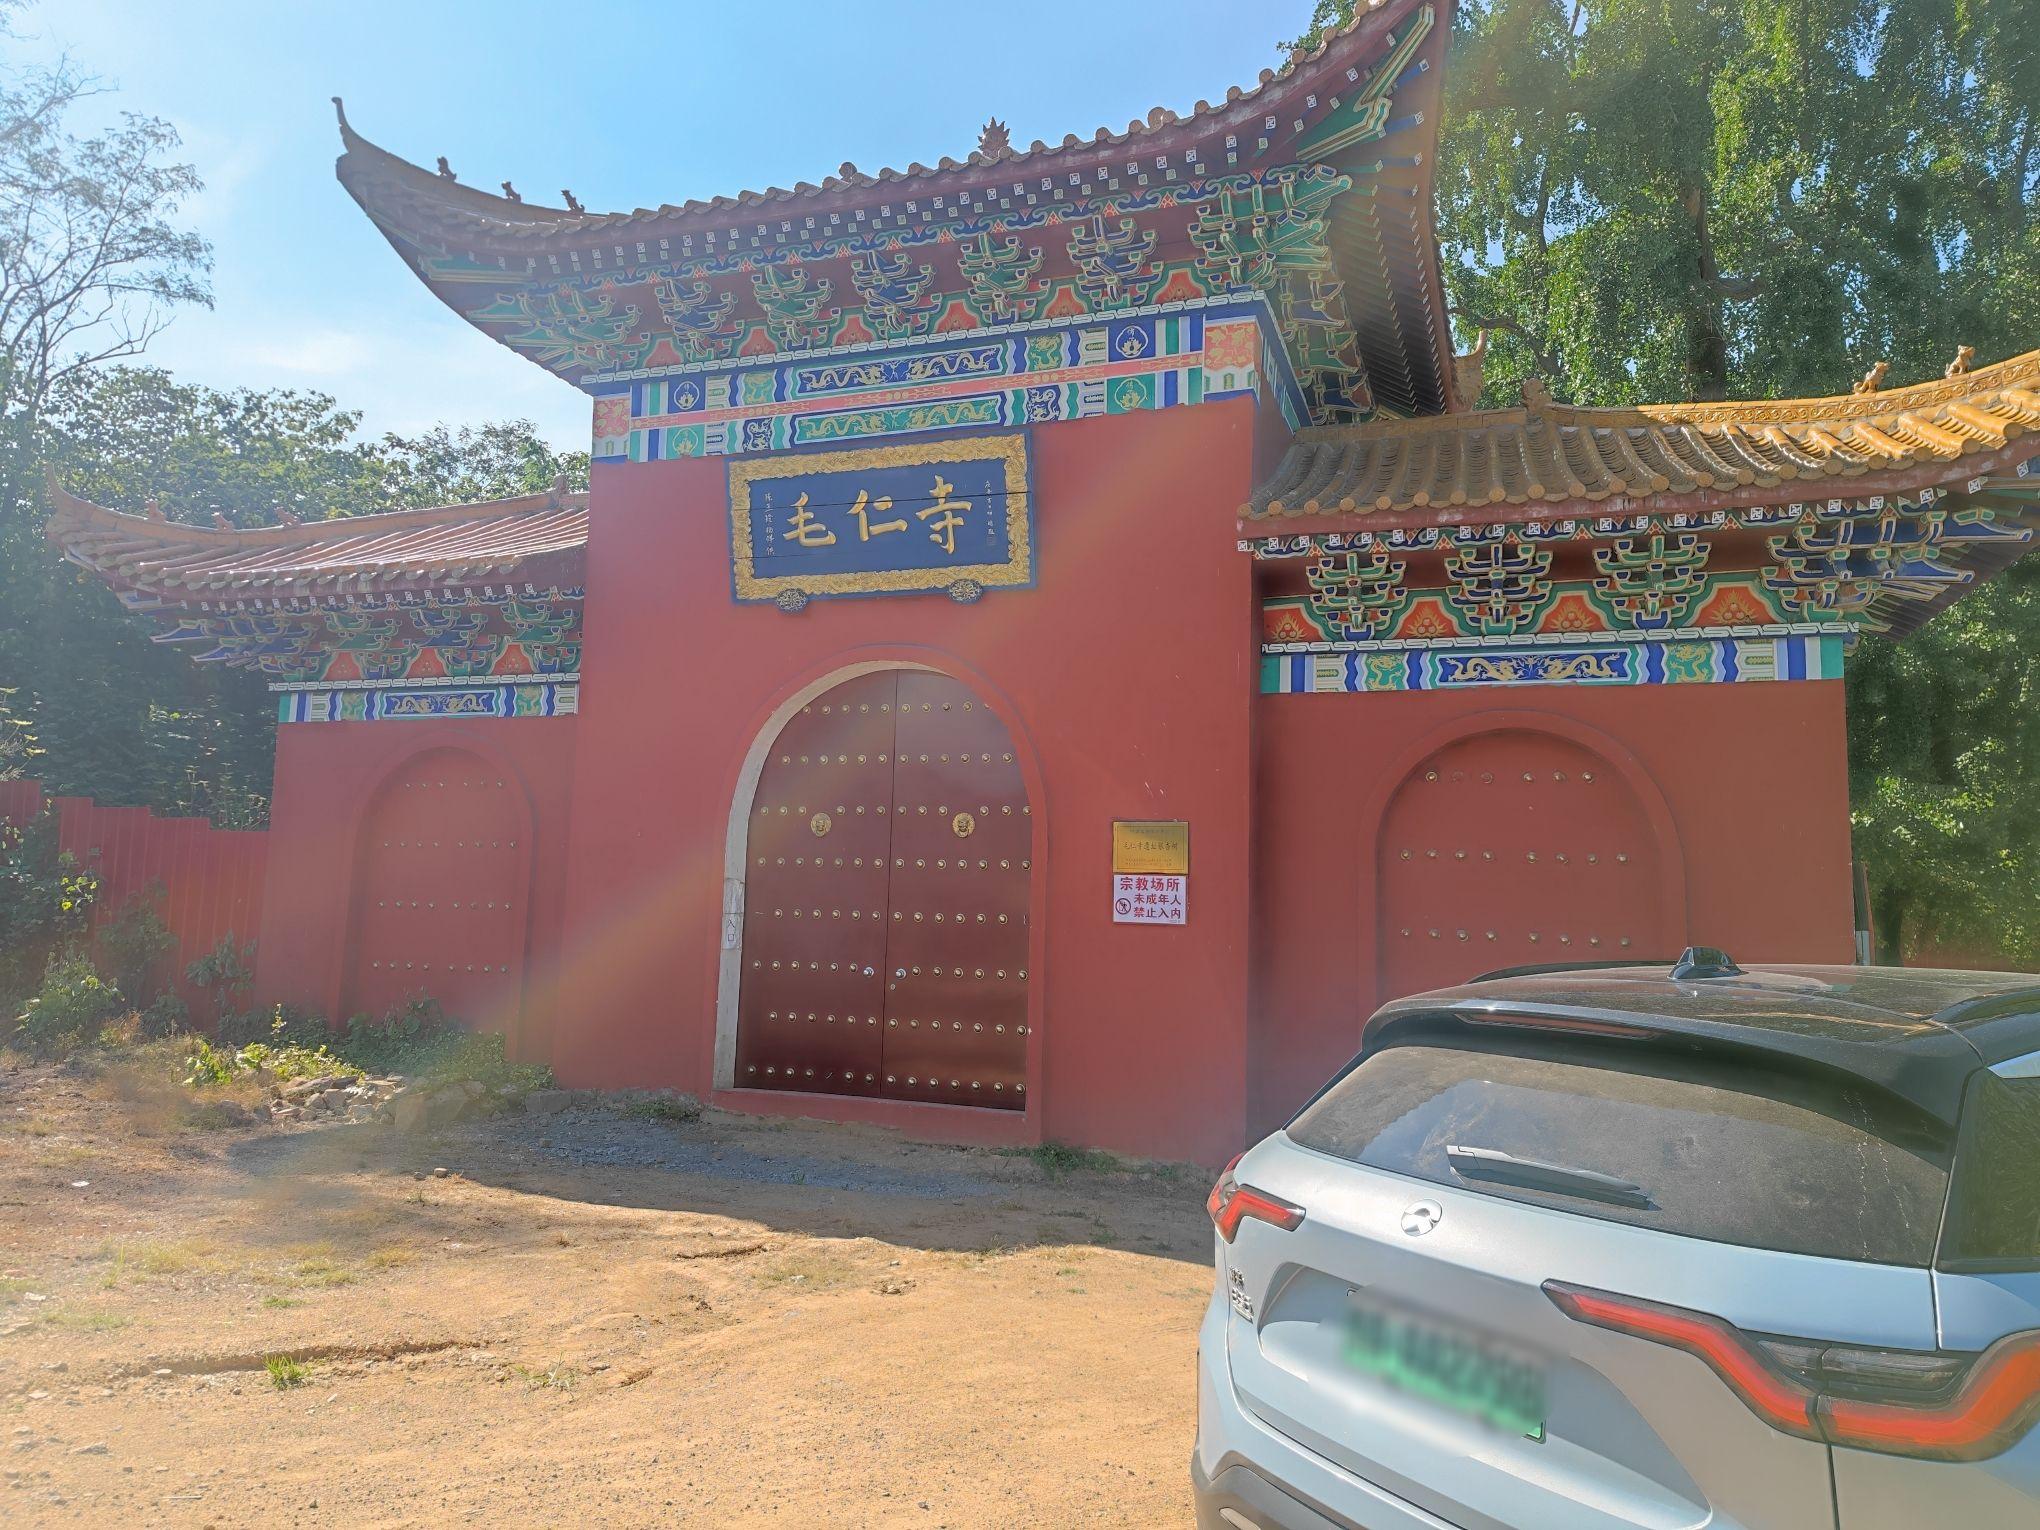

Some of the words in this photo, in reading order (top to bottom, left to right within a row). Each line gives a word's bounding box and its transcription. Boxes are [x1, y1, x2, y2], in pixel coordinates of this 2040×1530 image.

[782, 475, 973, 554] 毛仁寺
[1120, 877, 1180, 892] 宗教场所
[1133, 893, 1182, 905] 未成年人
[1133, 907, 1181, 919] 禁止入内
